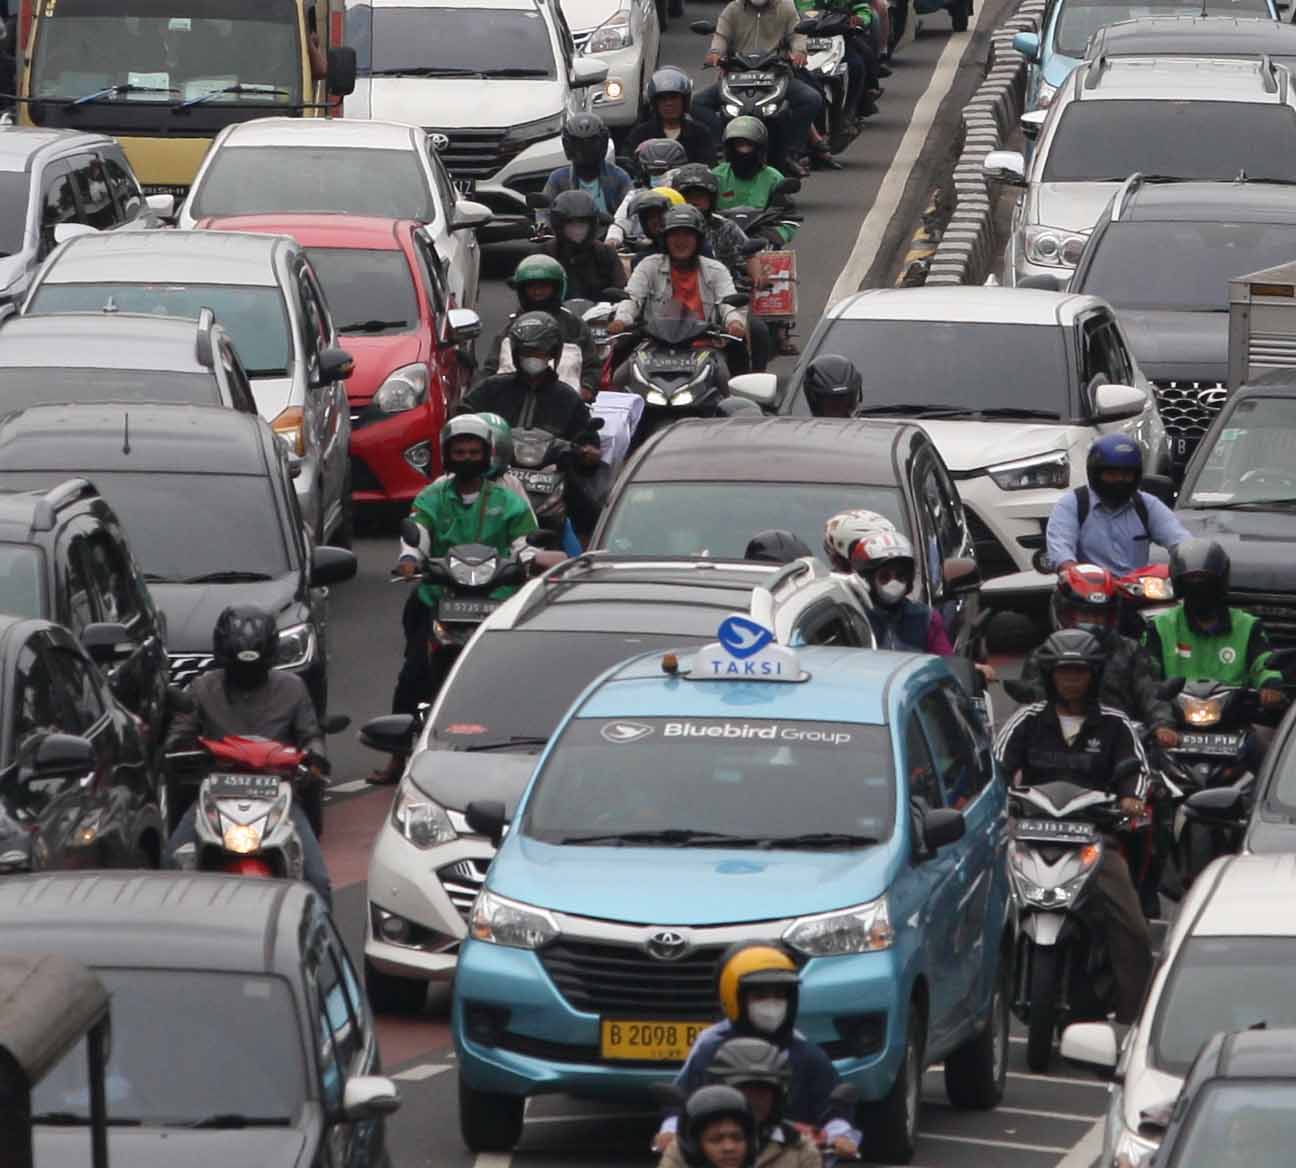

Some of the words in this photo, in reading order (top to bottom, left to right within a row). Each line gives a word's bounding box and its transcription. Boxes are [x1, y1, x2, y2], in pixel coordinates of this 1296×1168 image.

[711, 660, 782, 675] TAKSI
[663, 722, 778, 740] Bluebird
[780, 727, 852, 745] Group
[609, 1024, 621, 1046] B
[628, 1024, 677, 1046] 2098
